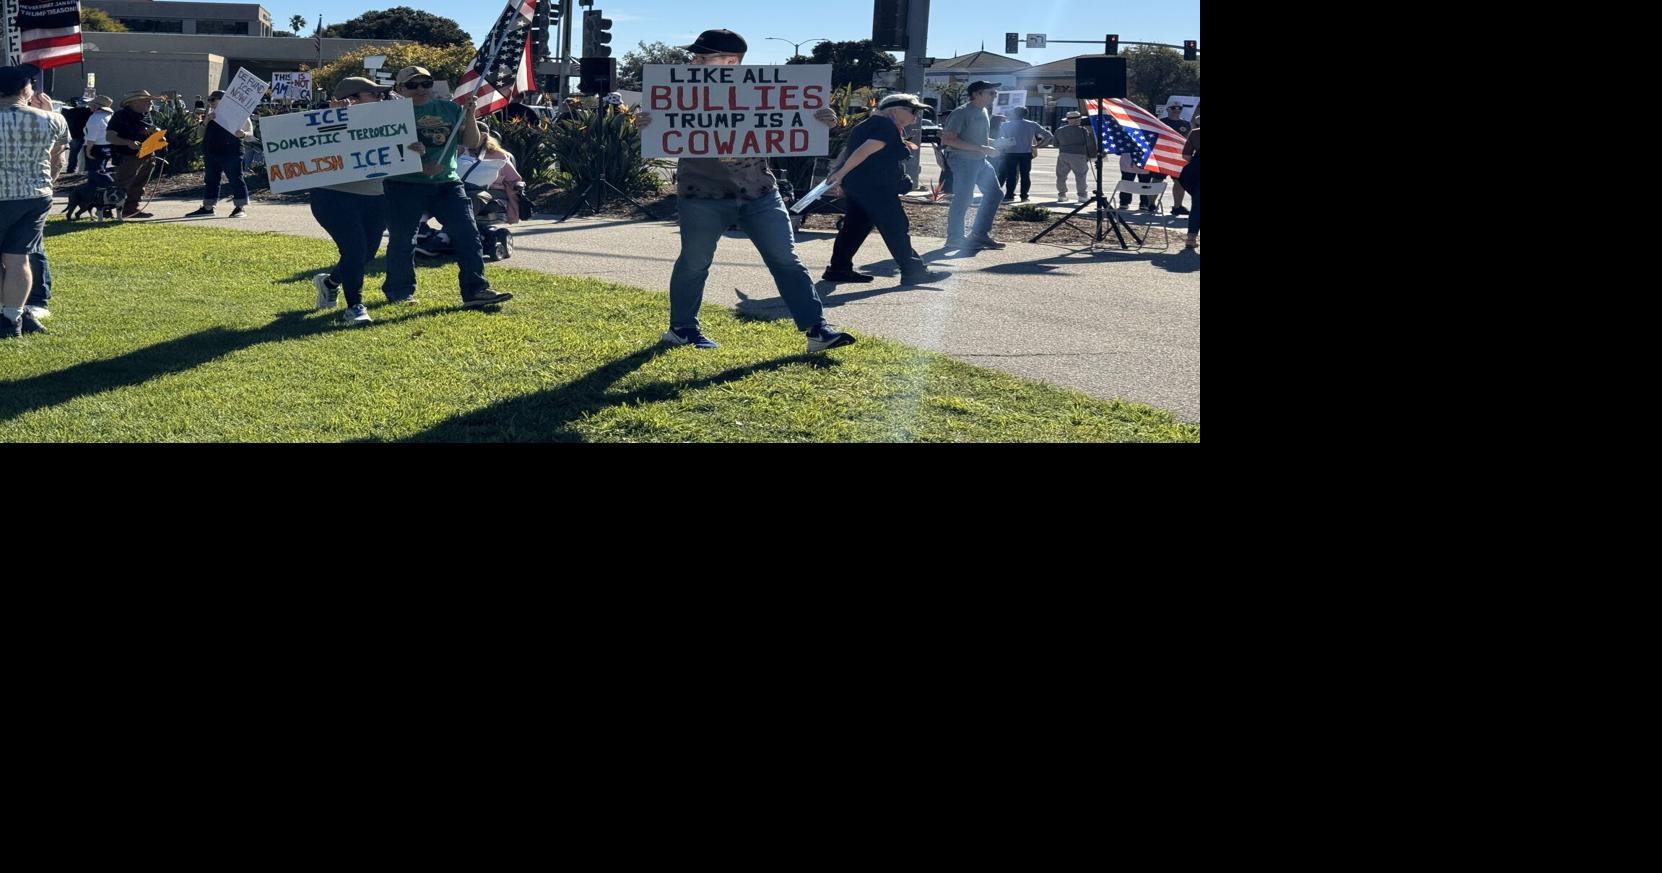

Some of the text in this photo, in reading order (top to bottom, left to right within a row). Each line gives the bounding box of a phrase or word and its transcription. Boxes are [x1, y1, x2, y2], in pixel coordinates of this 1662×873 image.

[274, 73, 291, 81] THIS
[294, 79, 310, 89] NOT
[670, 67, 788, 84] LIKE ALL
[650, 84, 824, 112] BULLIES
[303, 107, 349, 127] ICE
[664, 111, 804, 129] TRUMP IS A
[266, 122, 409, 154] DOMESTIC TERRORISM
[661, 128, 810, 156] COWARD
[269, 153, 344, 182] ABOLISH
